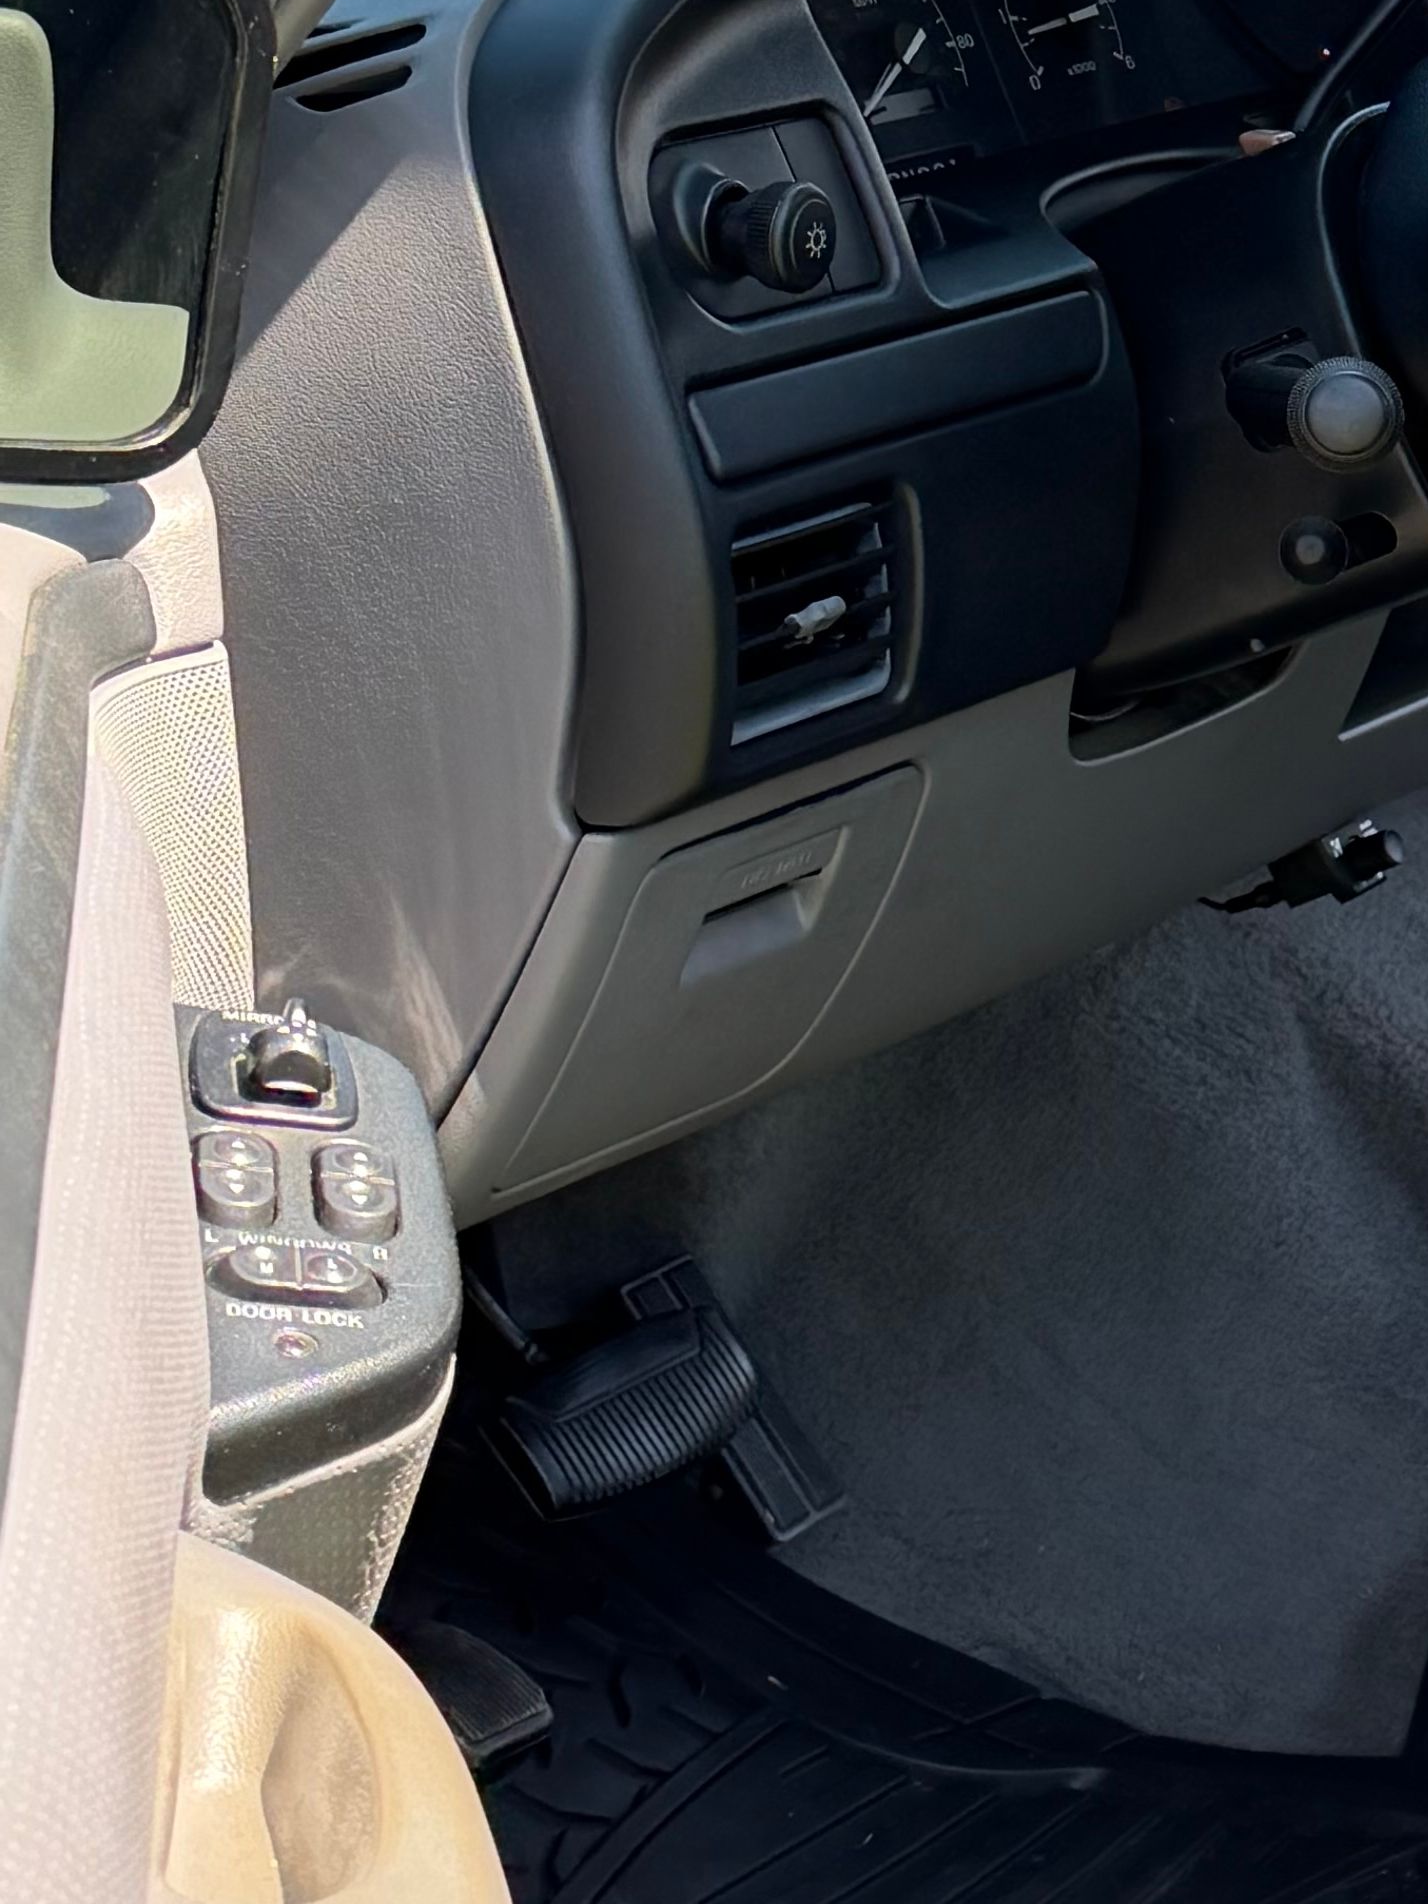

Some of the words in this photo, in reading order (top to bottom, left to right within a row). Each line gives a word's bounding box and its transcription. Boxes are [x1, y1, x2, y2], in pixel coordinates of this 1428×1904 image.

[956, 32, 975, 49] 80
[1125, 55, 1136, 70] 6
[1028, 75, 1041, 91] 0
[204, 1228, 219, 1243] L
[372, 1245, 388, 1260] R
[225, 1302, 293, 1322] DOOR
[301, 1310, 365, 1329] LOCK
